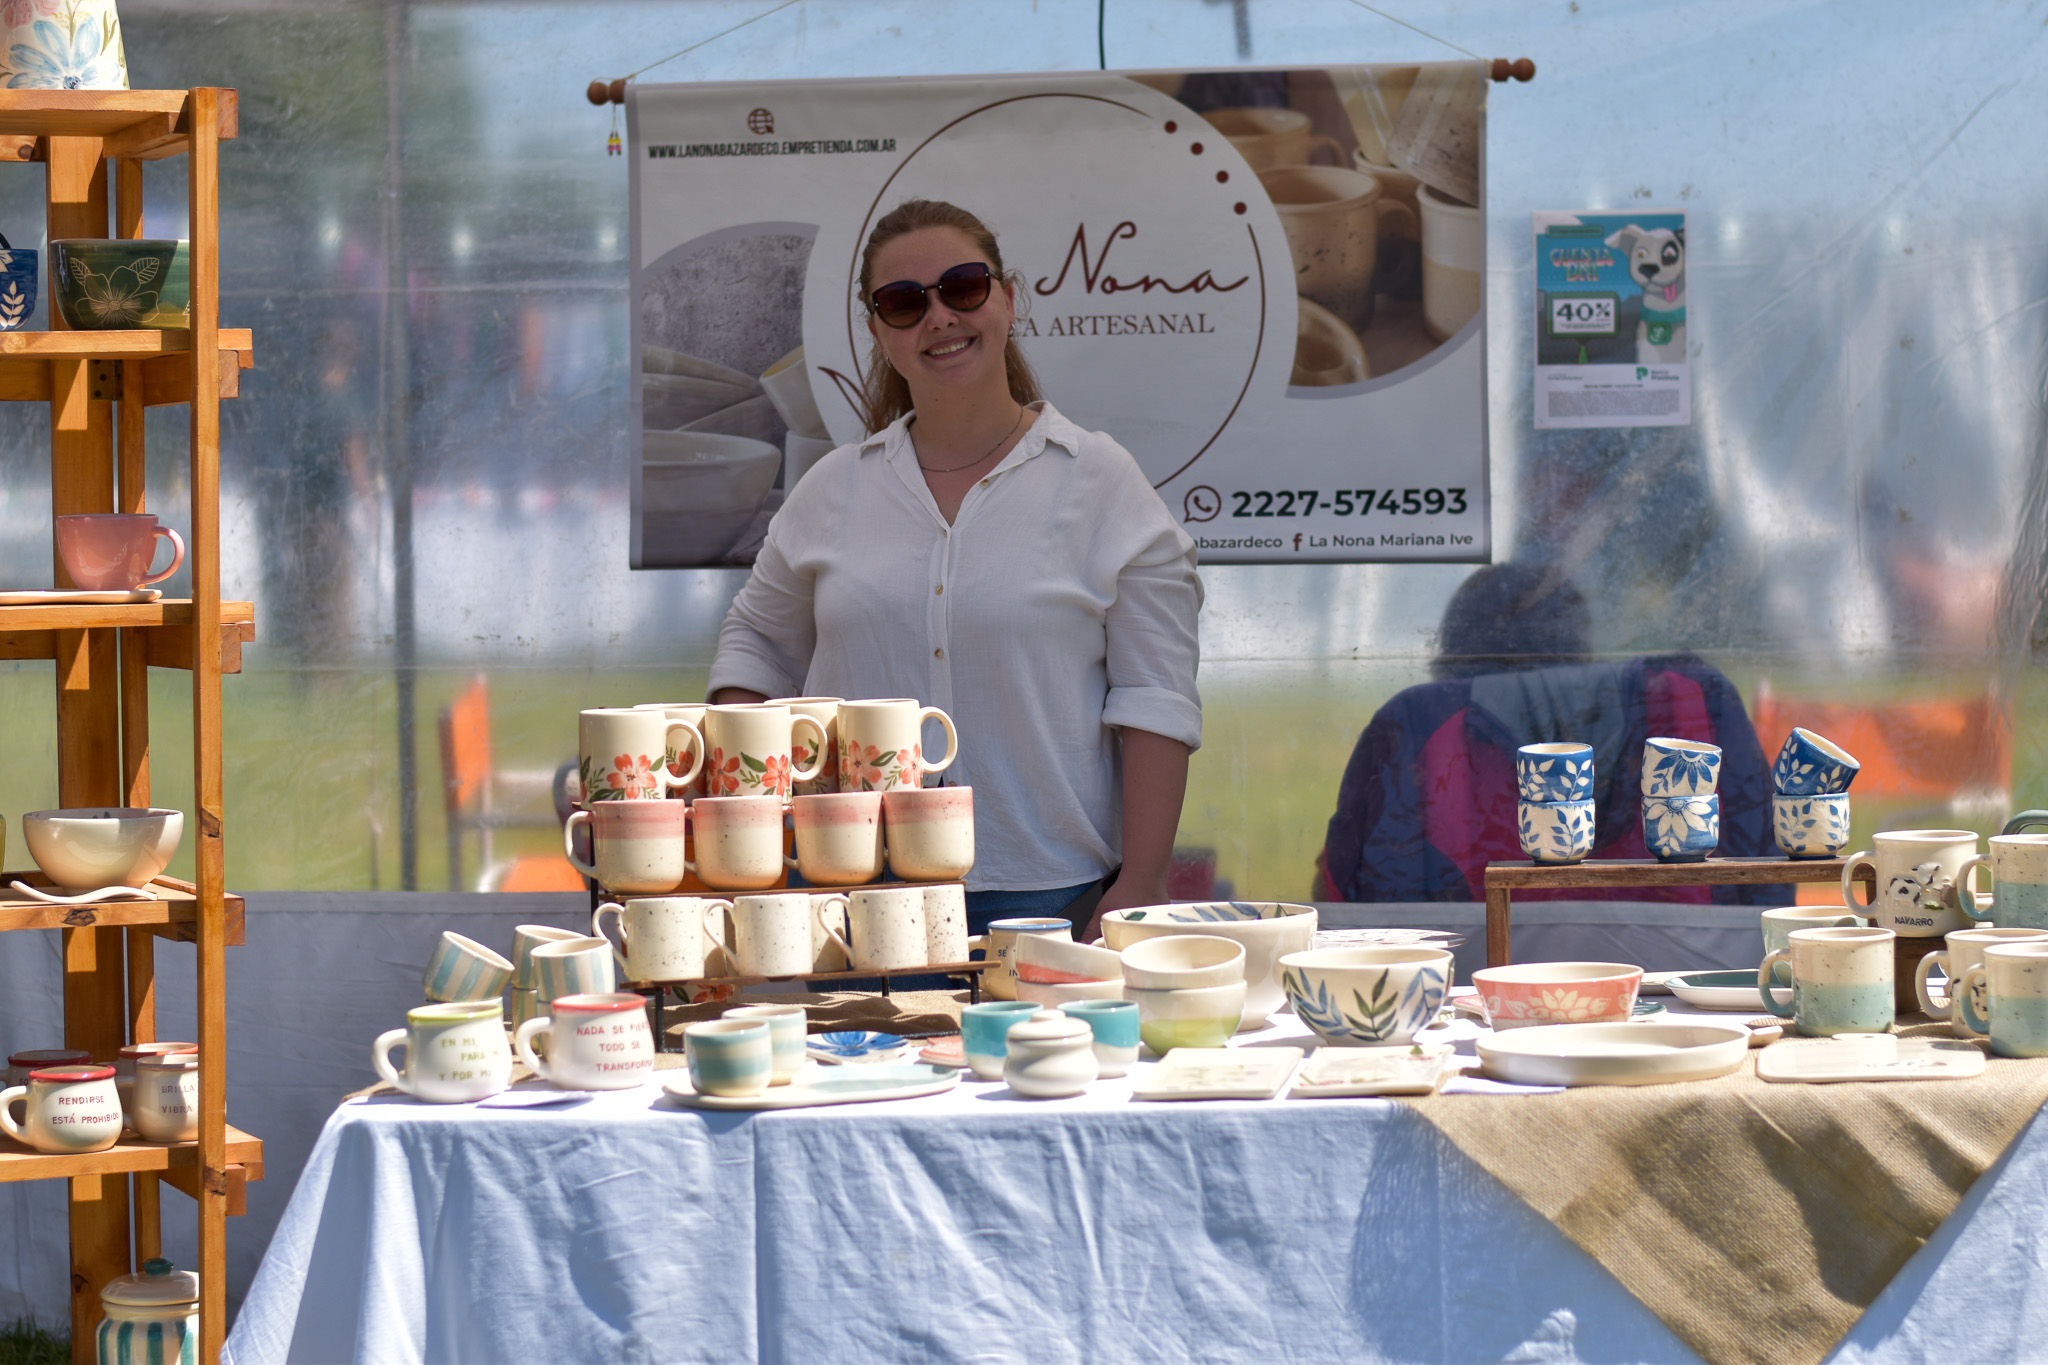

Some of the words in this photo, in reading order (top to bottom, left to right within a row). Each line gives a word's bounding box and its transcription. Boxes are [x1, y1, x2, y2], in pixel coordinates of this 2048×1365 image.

[648, 138, 897, 159] WWW.LANONABAZARDECO.EMPRETIENDA.COM.AR
[1034, 220, 1250, 297] Nona
[1556, 302, 1612, 321] 40%
[1048, 312, 1216, 338] ARTESANAL
[1231, 487, 1468, 518] 2227-574593
[1309, 534, 1328, 547] La
[1332, 534, 1376, 547] Nona
[1380, 532, 1446, 547] Mariana
[1449, 532, 1474, 545] Ive
[1894, 915, 1934, 927] NAVARRO
[576, 1026, 606, 1037] NADA
[612, 1023, 625, 1035] SE
[599, 1042, 626, 1053] TODO
[631, 1040, 641, 1050] SE
[58, 1095, 105, 1106] RENDIRSE
[161, 1105, 193, 1114] VIBRA
[52, 1112, 76, 1125] ESTÁ
[81, 1111, 120, 1125] PROHIBIDO
